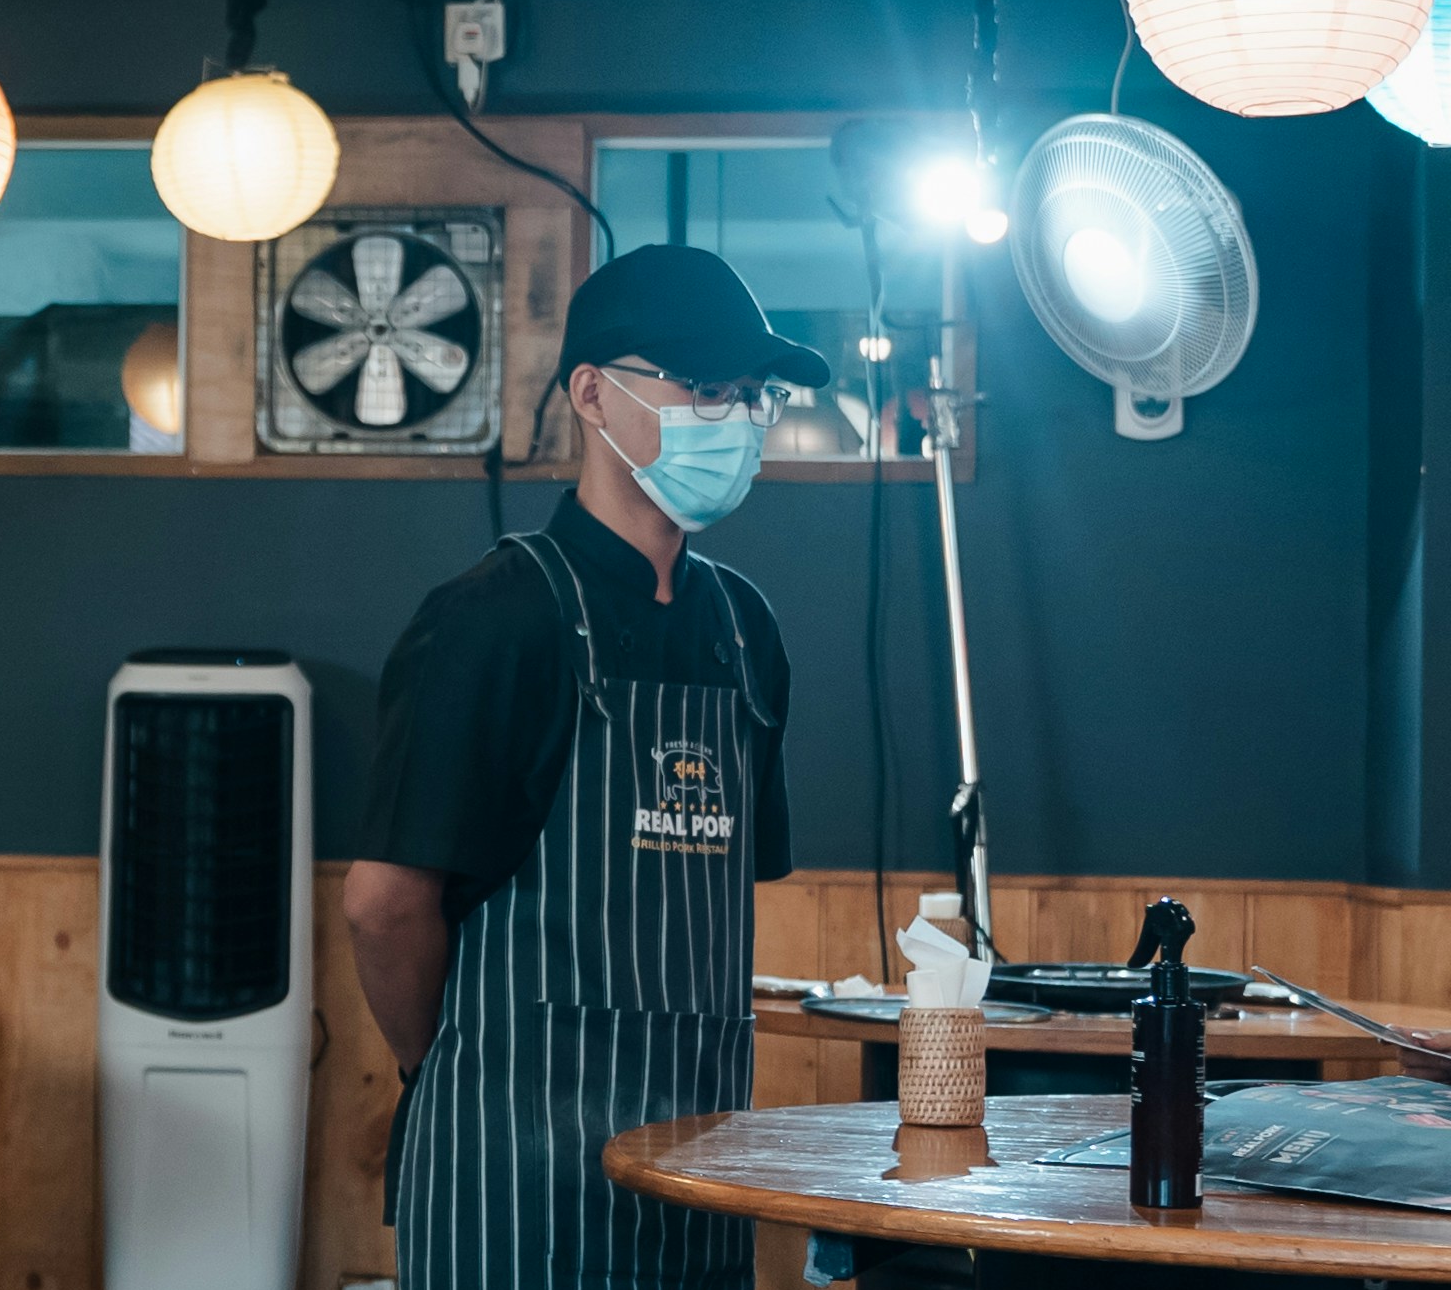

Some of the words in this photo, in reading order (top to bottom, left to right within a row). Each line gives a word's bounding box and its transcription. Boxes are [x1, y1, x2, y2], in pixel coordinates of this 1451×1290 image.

[634, 808, 687, 836] REAL
[692, 815, 734, 838] POR
[1269, 1129, 1331, 1164] MENU
